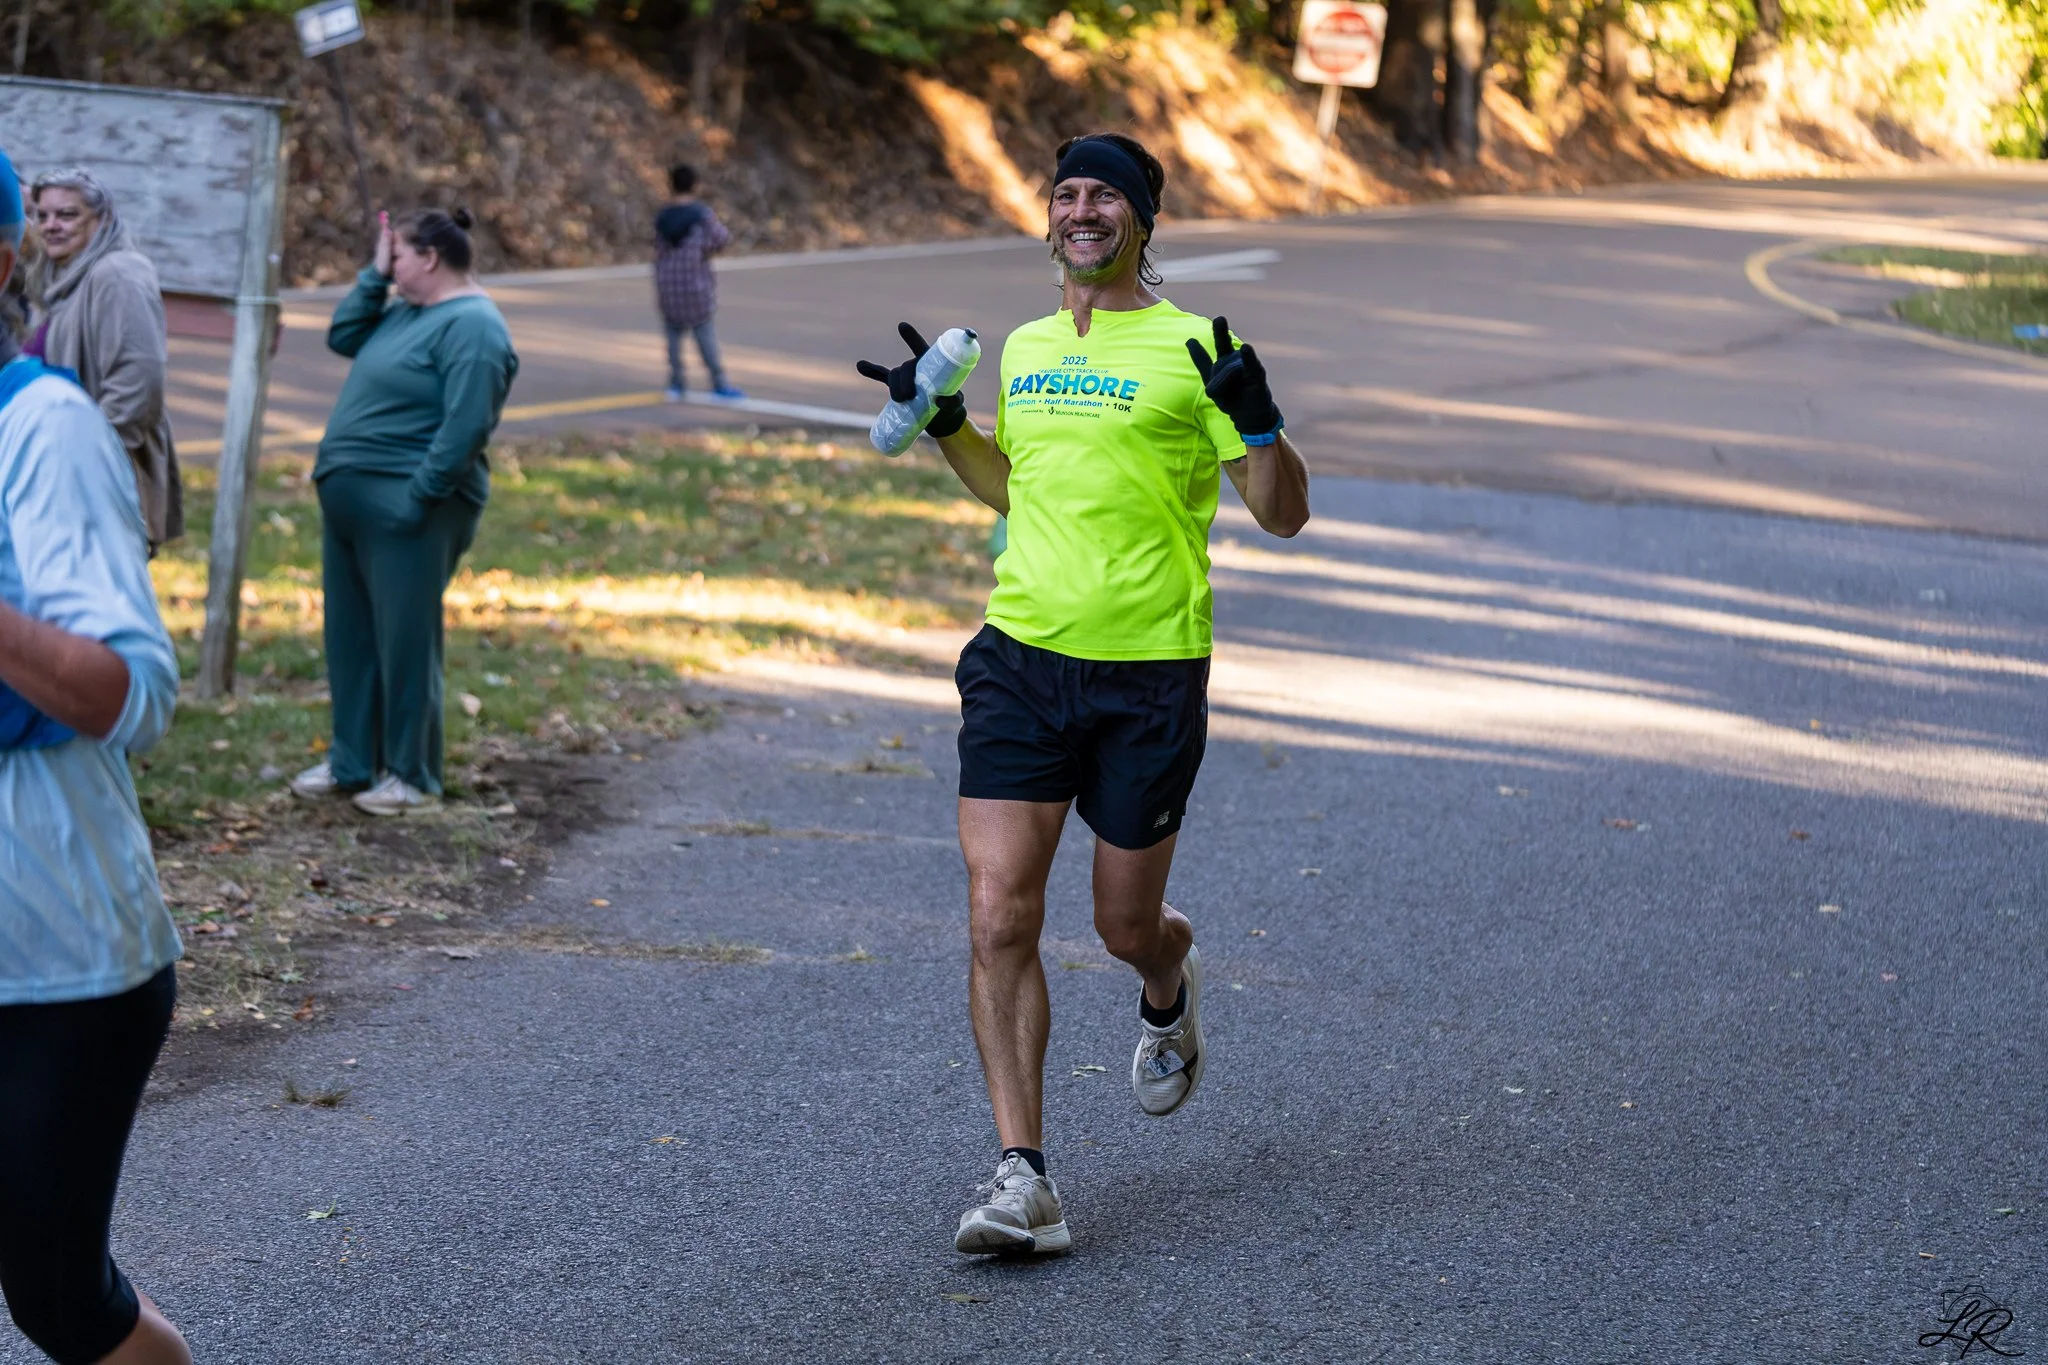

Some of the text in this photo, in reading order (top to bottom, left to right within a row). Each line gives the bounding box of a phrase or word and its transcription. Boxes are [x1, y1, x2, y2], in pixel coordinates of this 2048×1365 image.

[1061, 356, 1088, 365] 2025
[1009, 373, 1140, 402] BAYSHORE
[1063, 399, 1103, 408] Marathon
[1113, 402, 1132, 413] 10K
